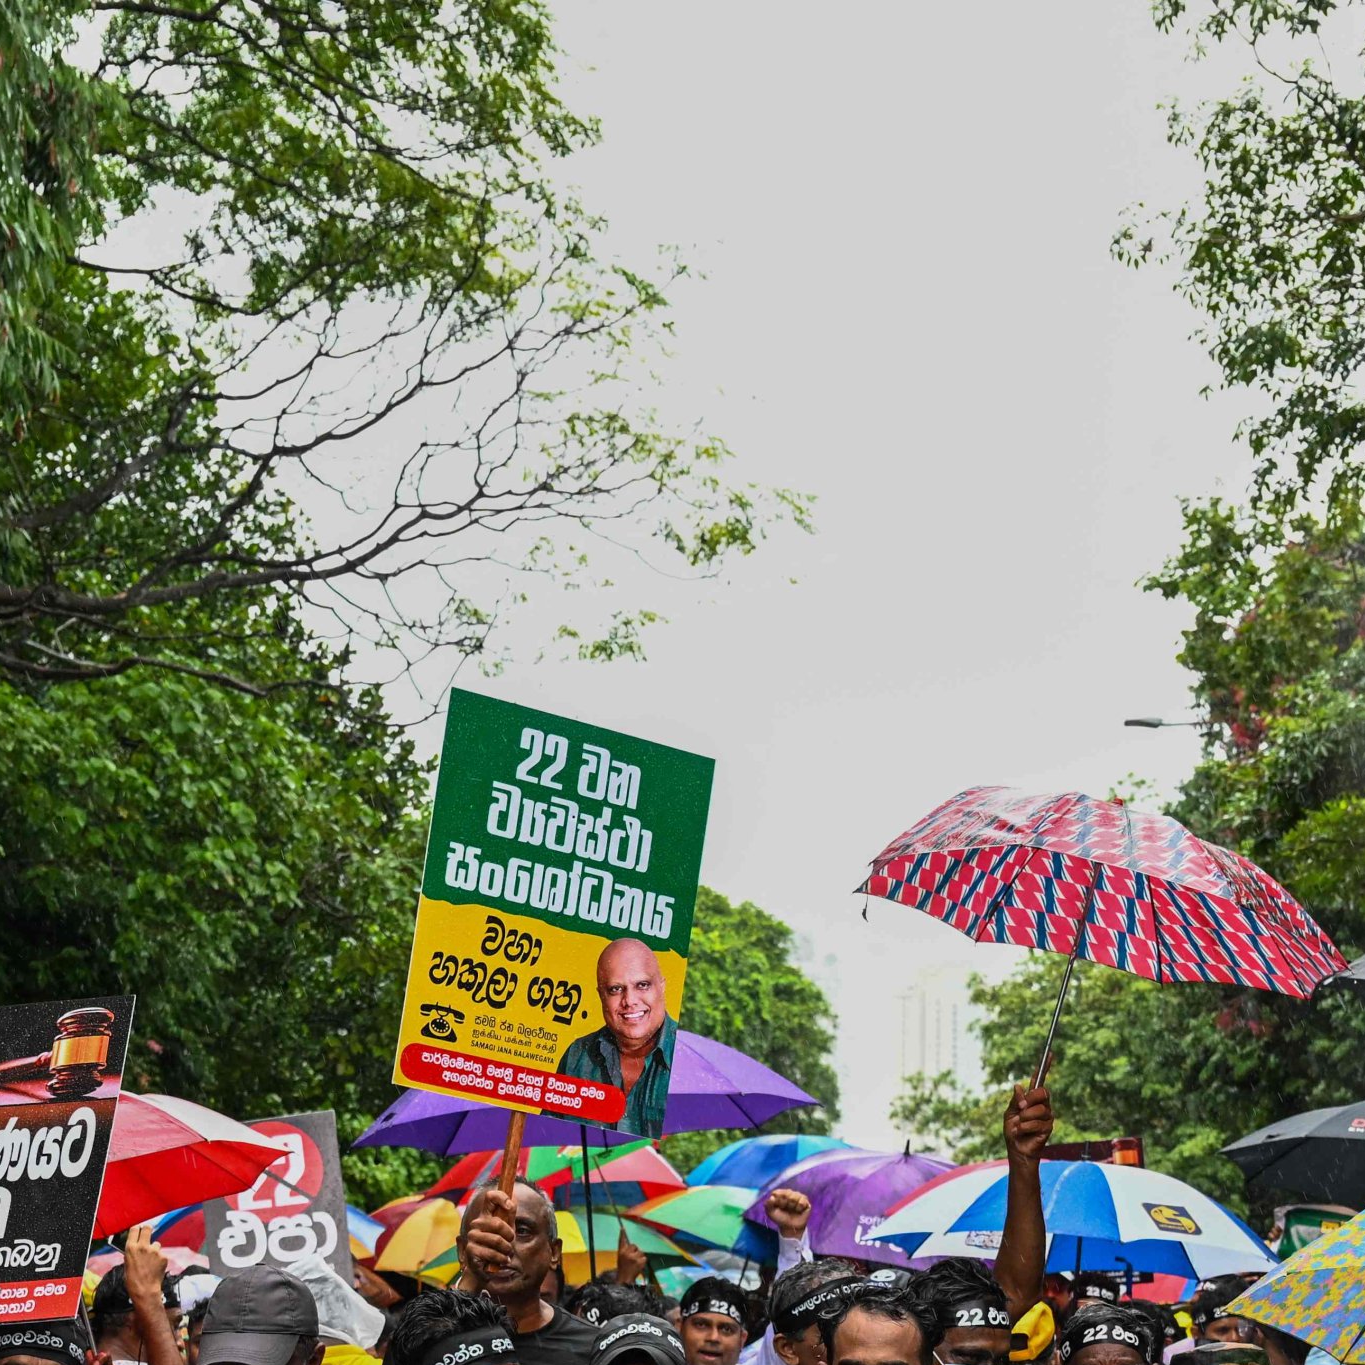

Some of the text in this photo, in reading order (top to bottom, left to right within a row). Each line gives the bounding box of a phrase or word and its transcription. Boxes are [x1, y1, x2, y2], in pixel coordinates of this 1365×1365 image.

[515, 727, 641, 810] 22 වන
[480, 914, 543, 967] වහා
[428, 951, 518, 1009] හකුලා
[471, 1040, 555, 1064] SAMAGI JANA BALAWEGAYA
[956, 1308, 985, 1327] 22
[1082, 1324, 1109, 1344] 22
